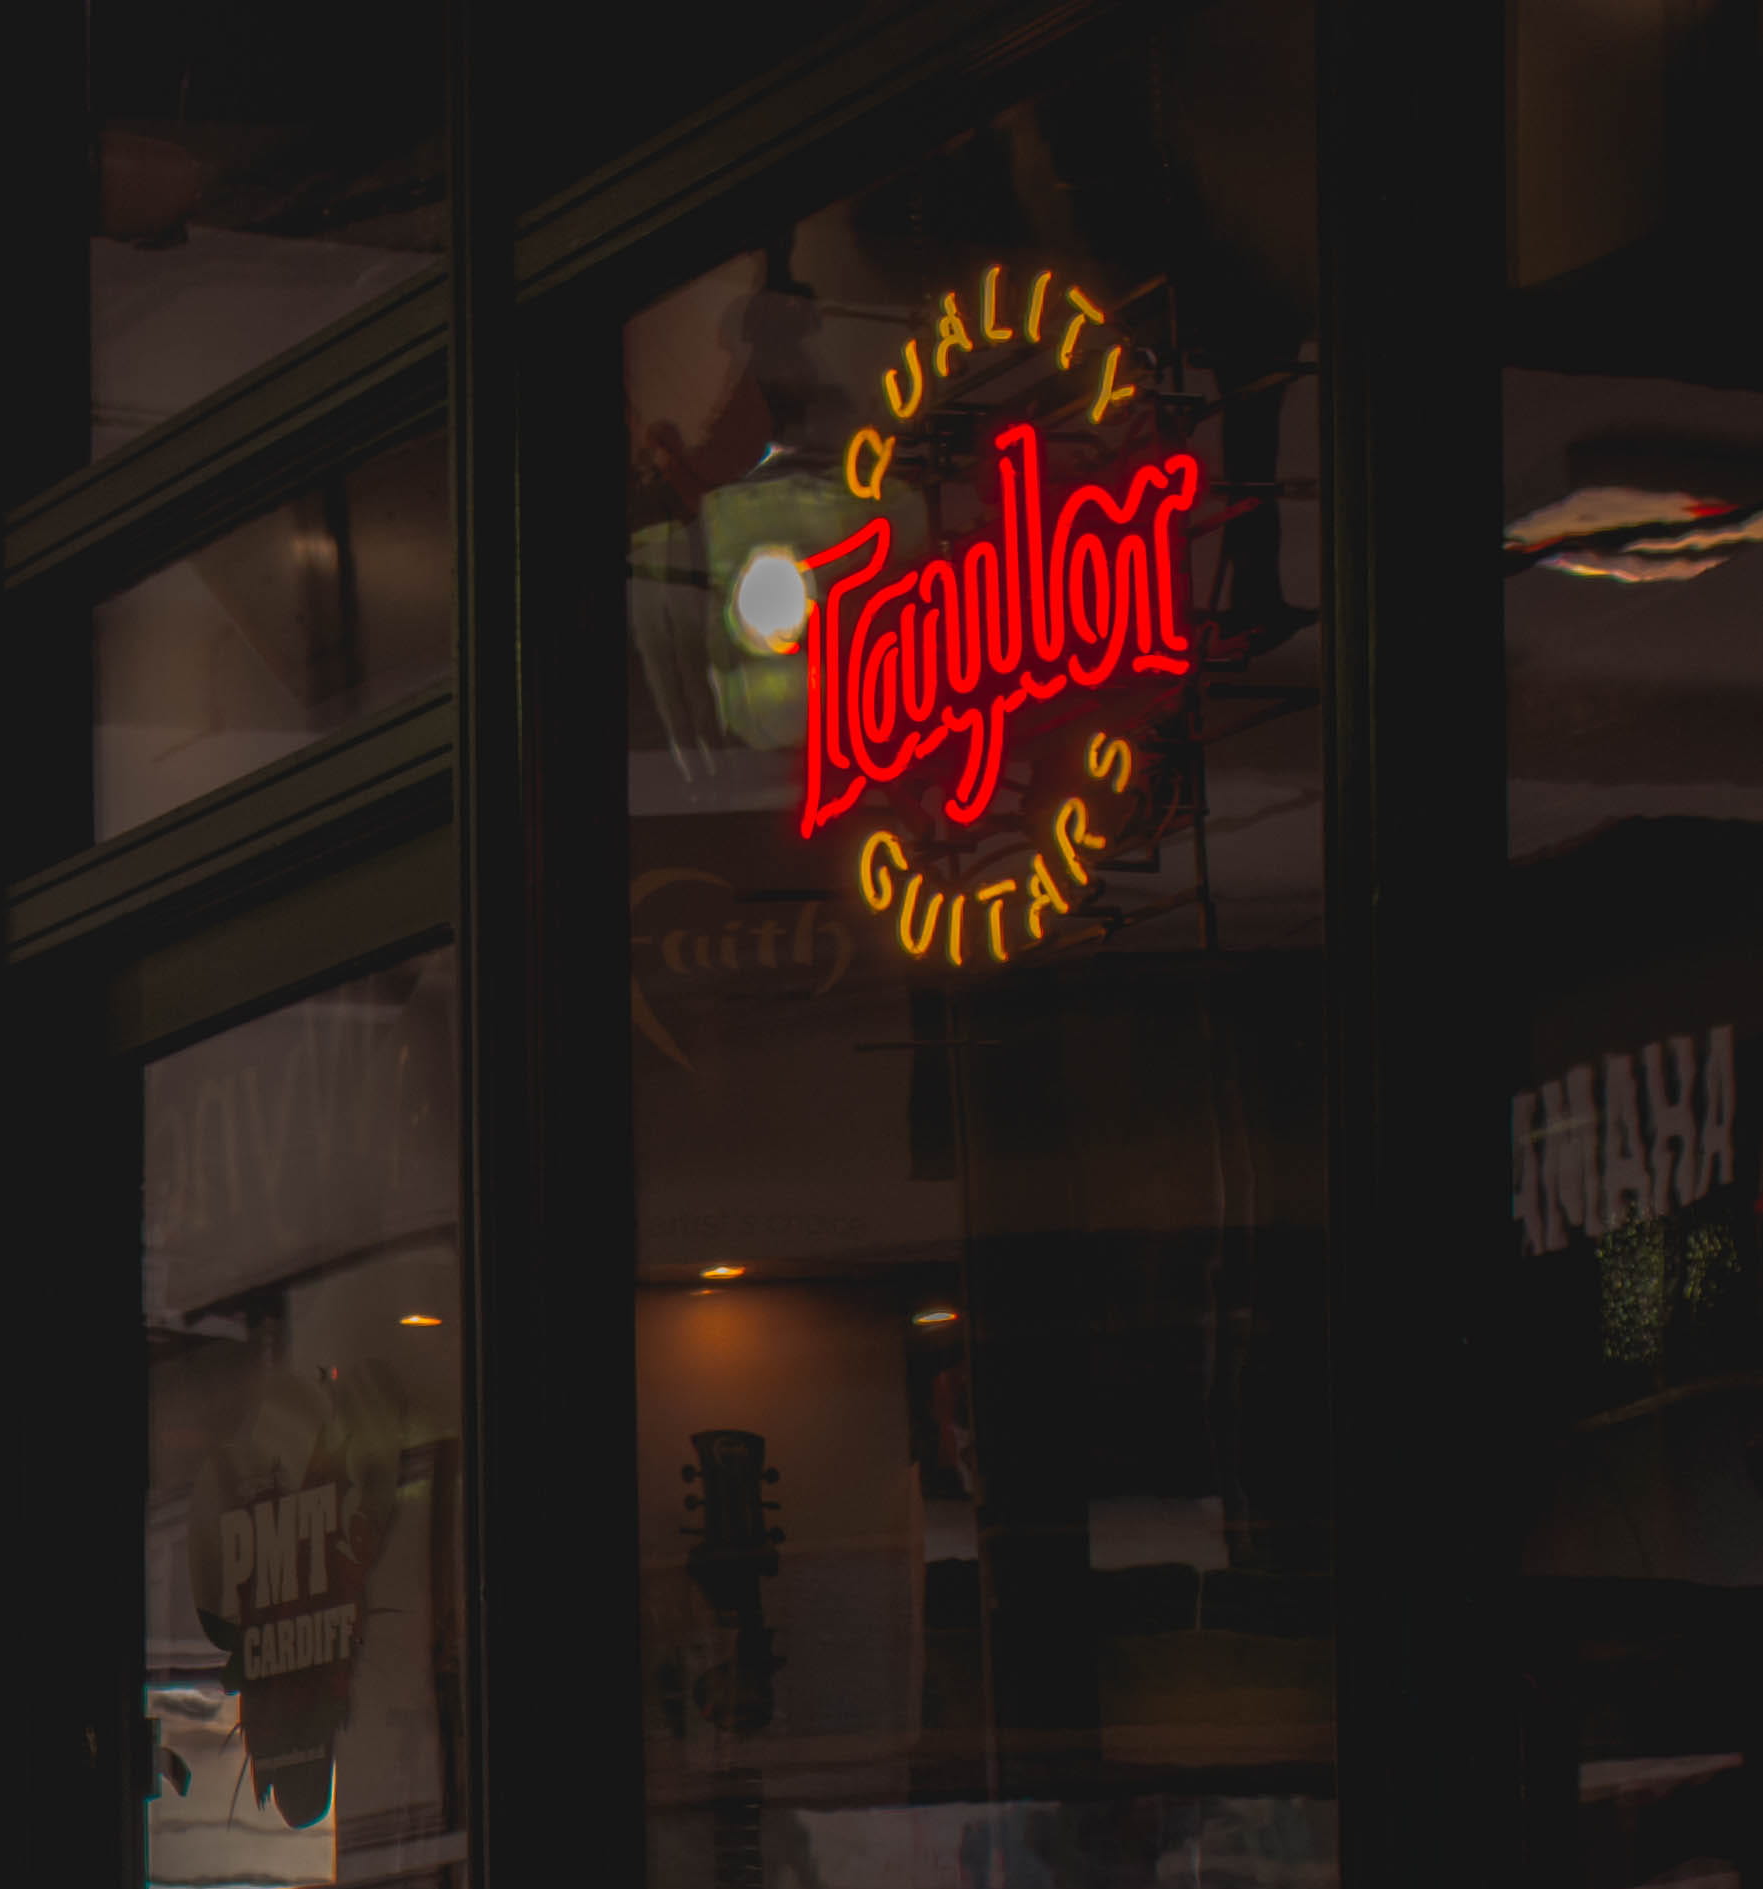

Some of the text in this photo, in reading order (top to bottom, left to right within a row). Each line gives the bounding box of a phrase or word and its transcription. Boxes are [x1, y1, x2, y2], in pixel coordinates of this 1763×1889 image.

[843, 264, 1136, 502] QUALITY
[786, 422, 1200, 839] Taylor
[859, 730, 1133, 967] GUITARS
[218, 1481, 337, 1625] PMT
[243, 1602, 359, 1682] CARDIFF
